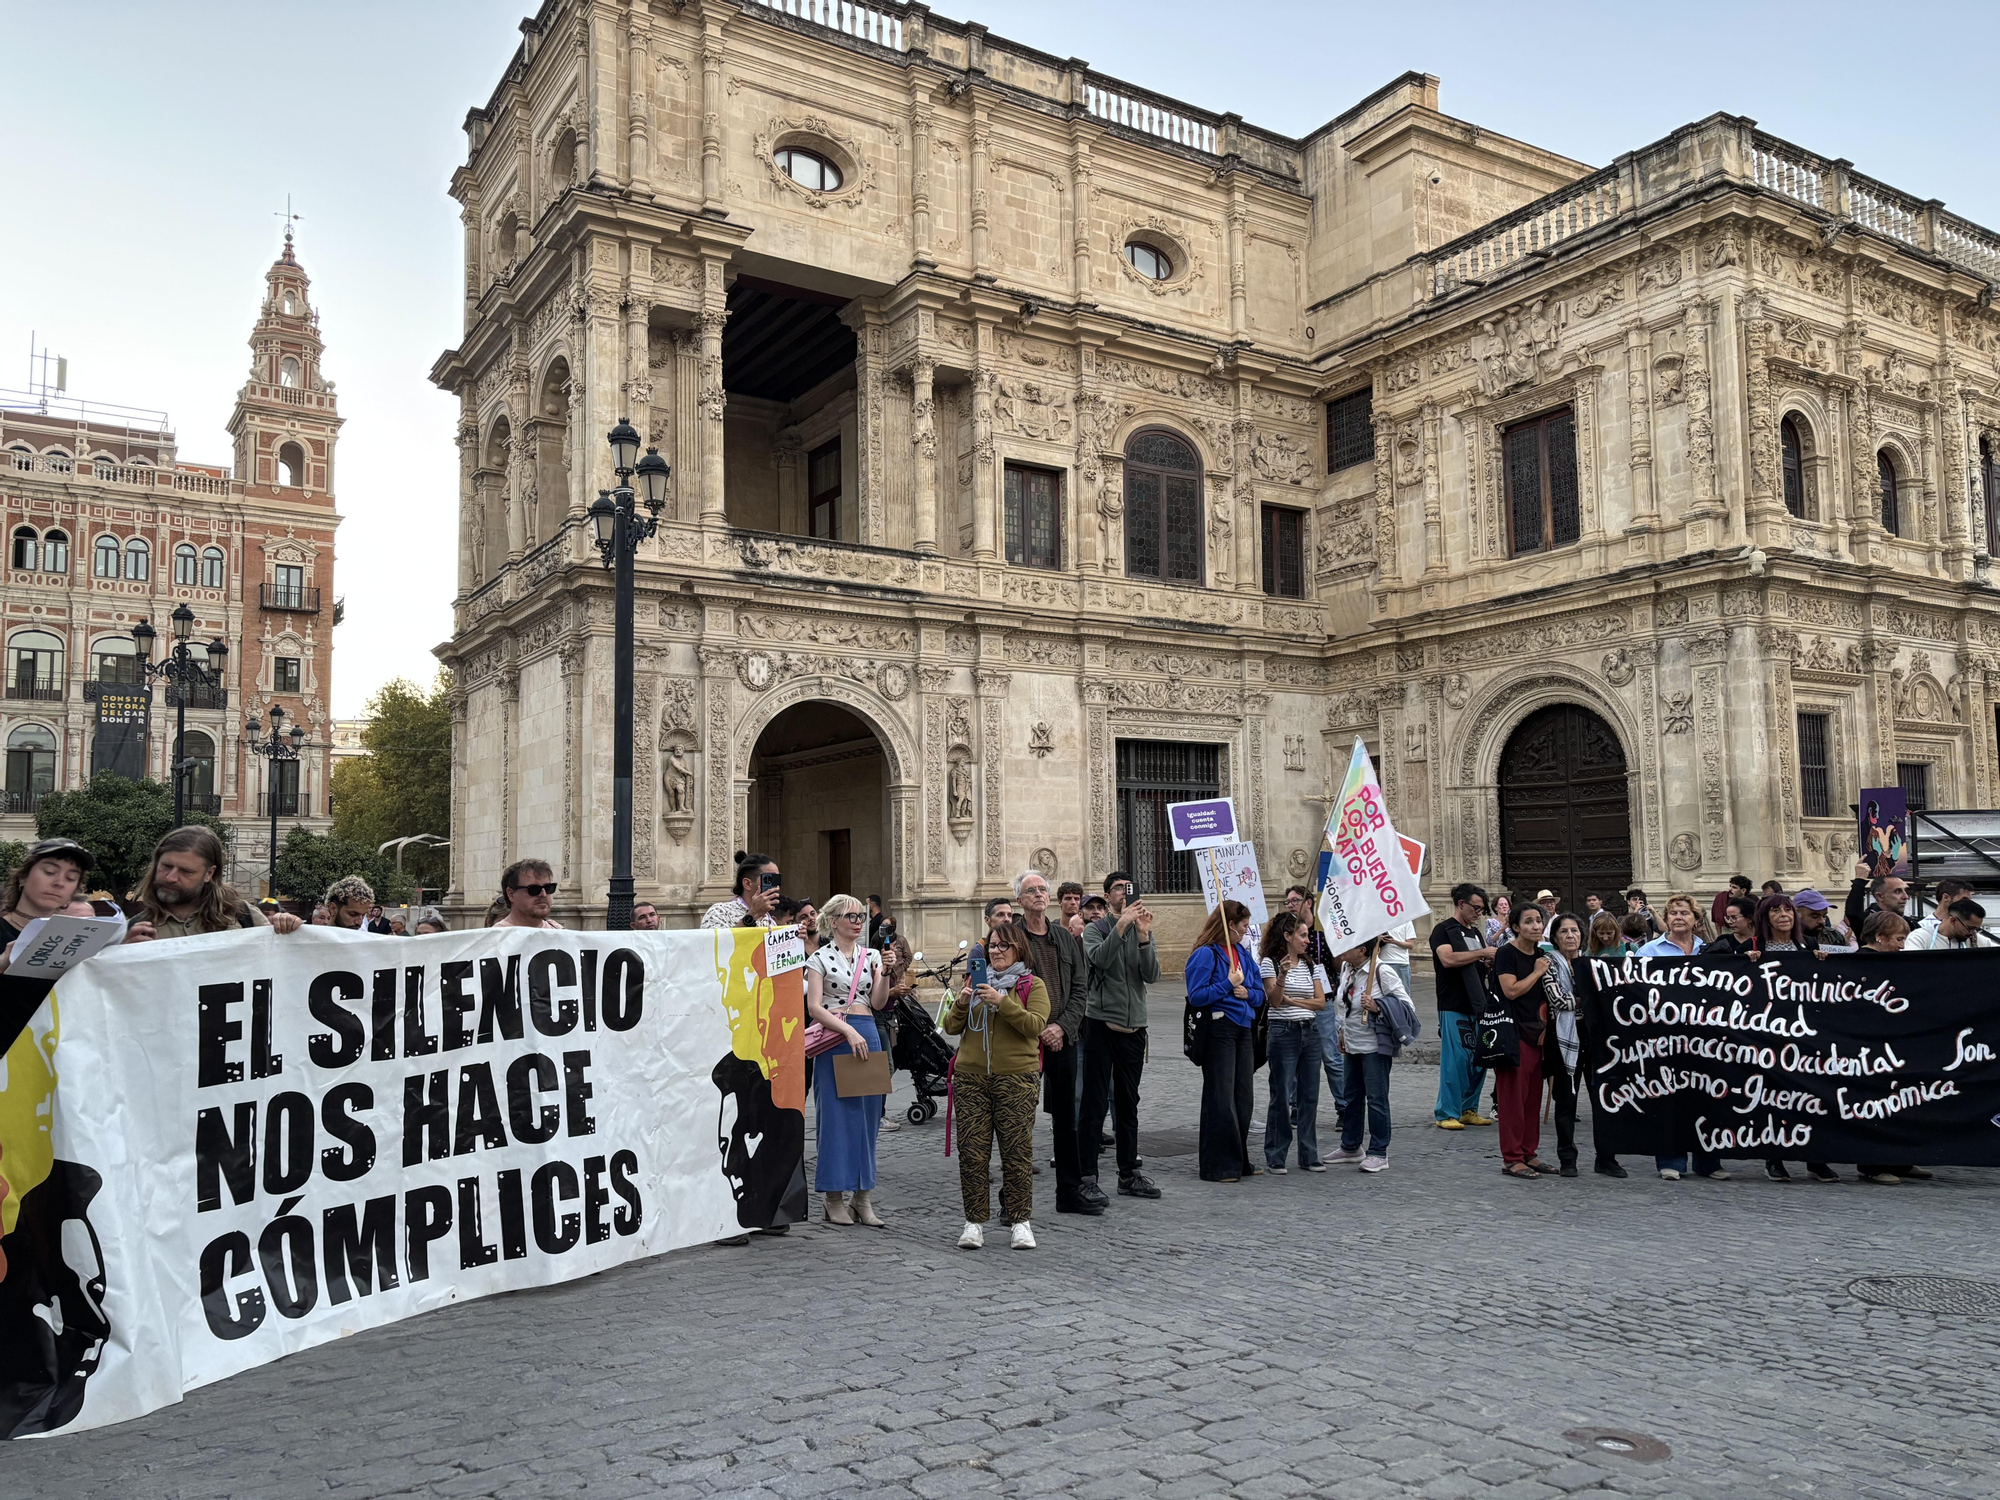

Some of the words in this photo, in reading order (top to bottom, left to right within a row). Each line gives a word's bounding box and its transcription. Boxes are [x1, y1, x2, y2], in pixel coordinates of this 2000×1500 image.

[102, 695, 146, 703] CONSTR
[102, 702, 146, 710] UCTORA
[1357, 785, 1385, 832] POR
[1197, 843, 1250, 861] "FMINISM
[1343, 798, 1368, 840] LOS
[1360, 837, 1404, 917] BUENOS
[767, 930, 799, 946] CAMBIO
[777, 951, 791, 960] POR
[770, 954, 804, 970] TERNURA
[1590, 951, 1753, 996] Militarismo
[1758, 960, 1909, 1013] Feminicidio
[198, 978, 283, 1088] EL
[309, 948, 645, 1068] SILENCIO
[1613, 988, 1817, 1037] Colonialidad
[1596, 1035, 1776, 1075] Supremacismo
[1780, 1043, 1905, 1077] Occidental
[1837, 1080, 1962, 1120] Económica
[196, 1082, 376, 1214] NOS
[402, 1050, 597, 1167] HACE
[1694, 1114, 1812, 1152] Ecocidio
[199, 1150, 643, 1341] CÓMPLICES
